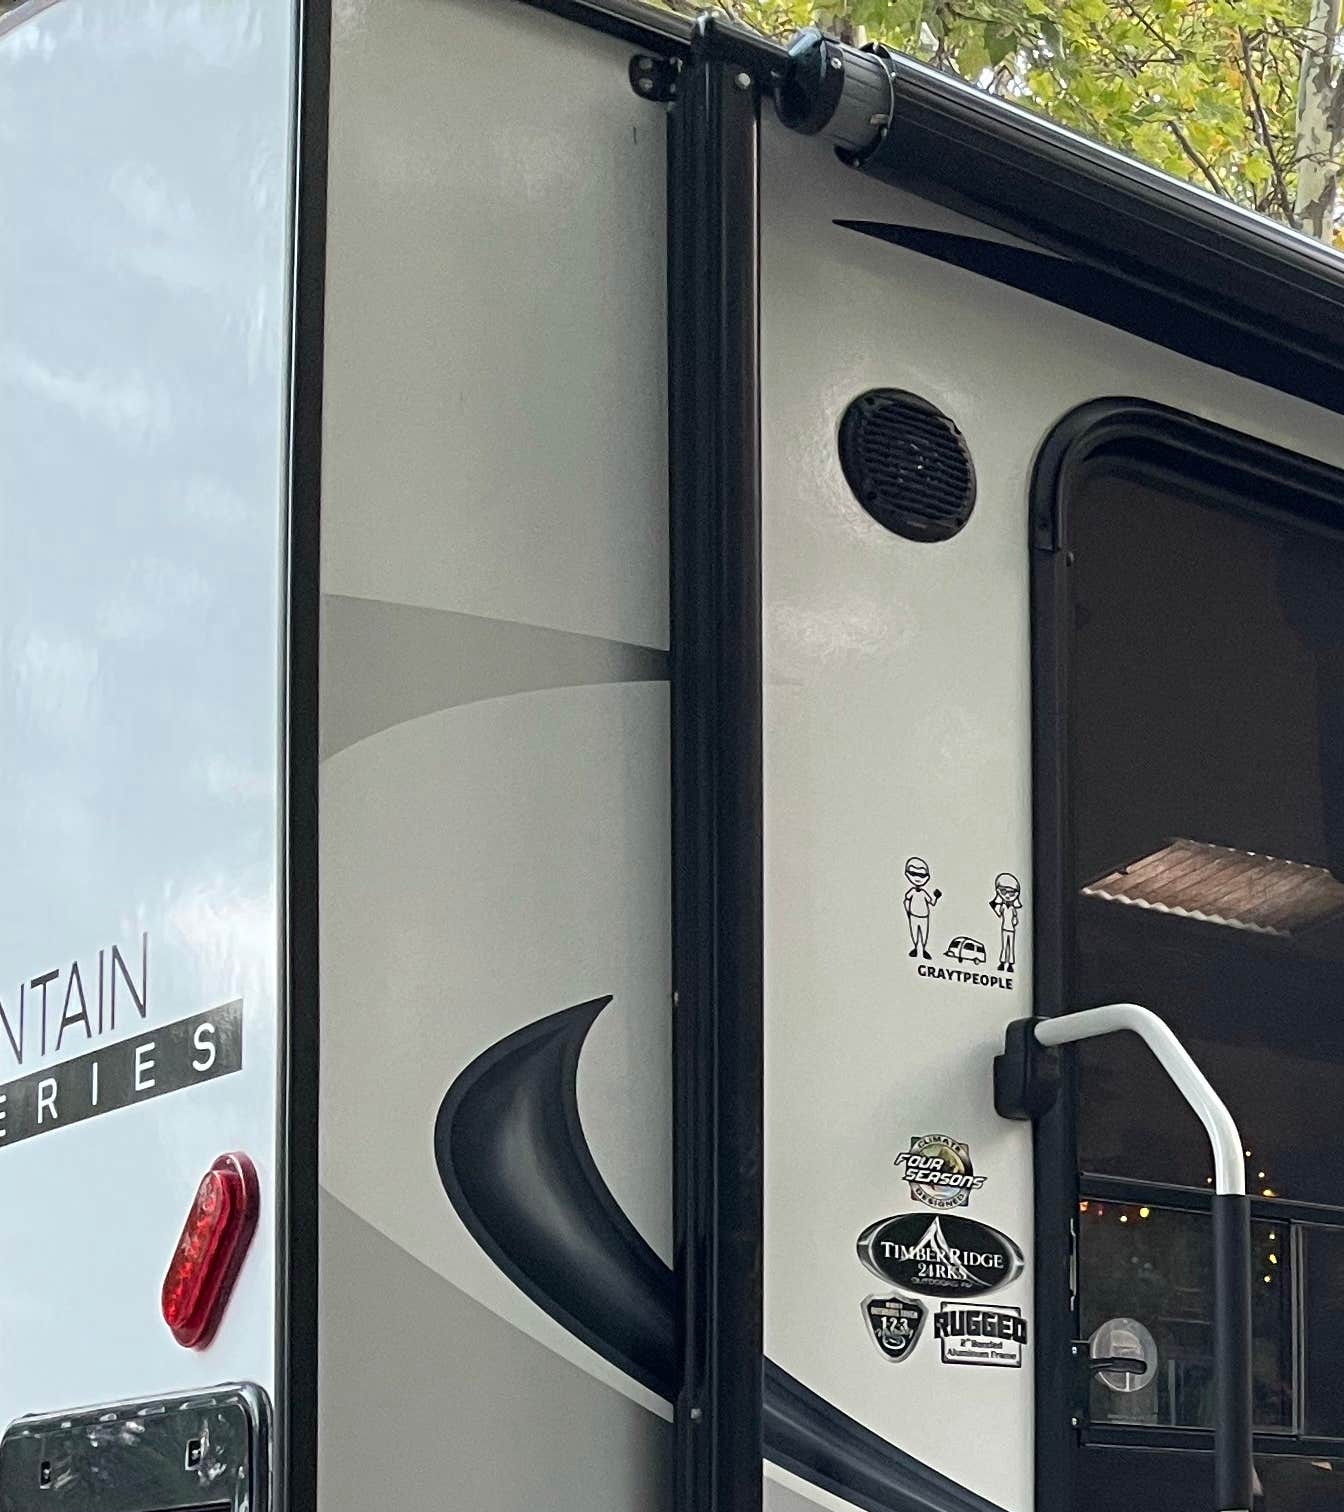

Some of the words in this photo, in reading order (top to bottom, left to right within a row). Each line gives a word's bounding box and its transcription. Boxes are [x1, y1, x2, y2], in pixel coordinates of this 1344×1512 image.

[917, 964, 1013, 990] GRAYTPEOPLE
[895, 1153, 945, 1171] FOUR
[904, 1168, 987, 1189] SEASONS
[915, 1187, 965, 1208] DESIGNED
[934, 1310, 1028, 1345] RUGGED
